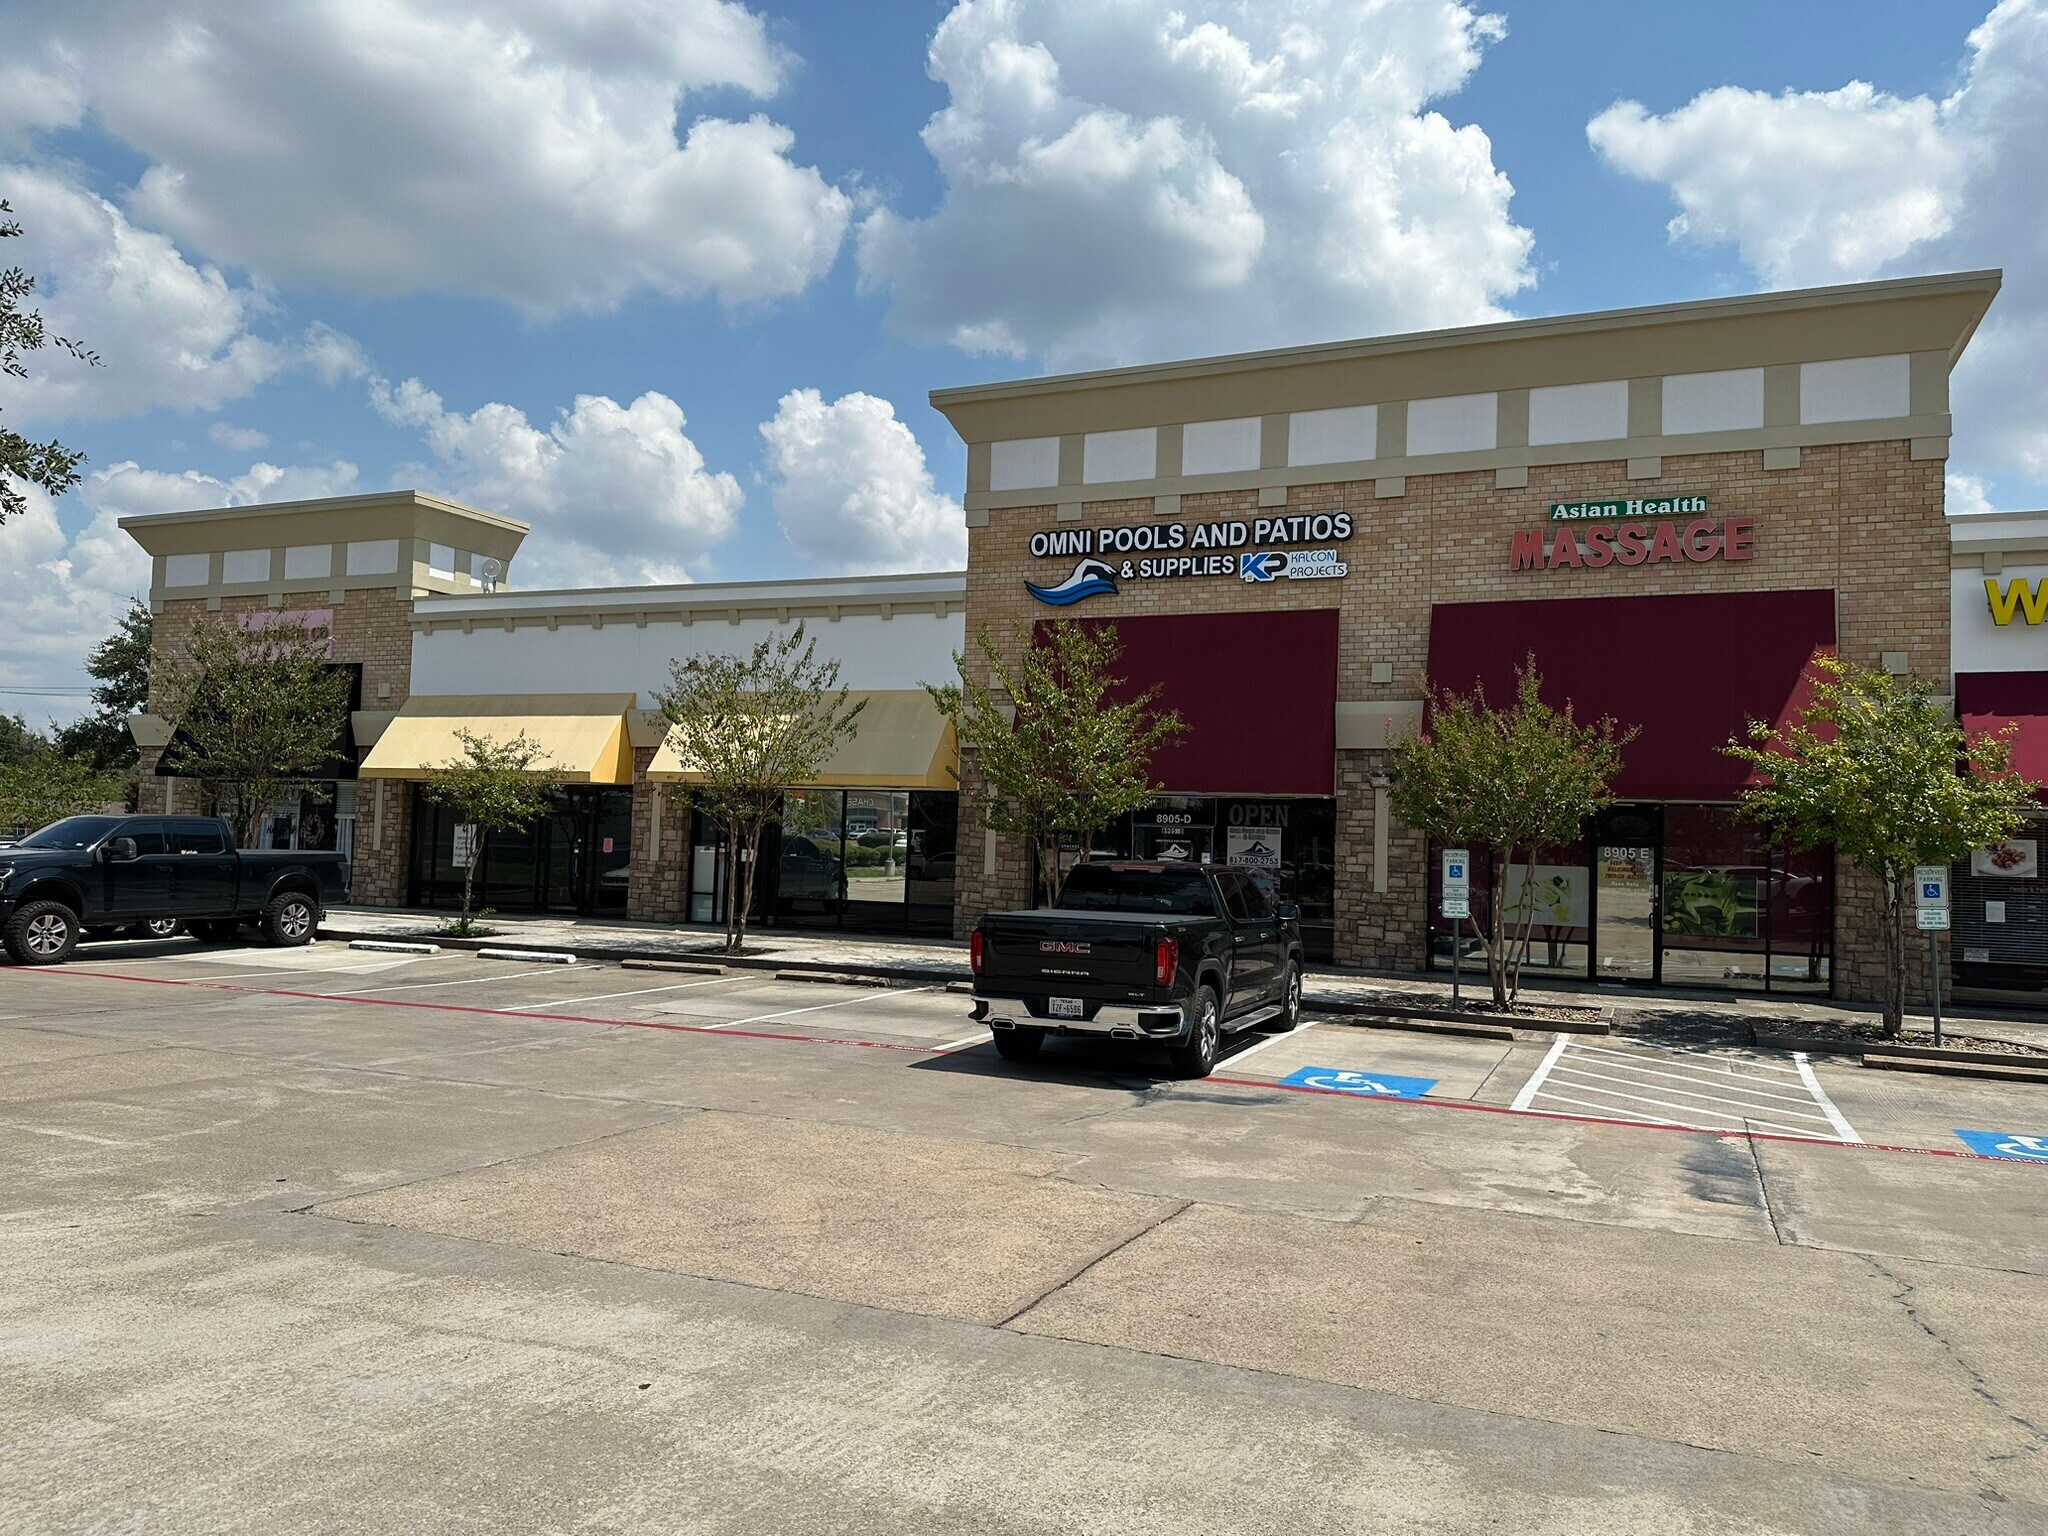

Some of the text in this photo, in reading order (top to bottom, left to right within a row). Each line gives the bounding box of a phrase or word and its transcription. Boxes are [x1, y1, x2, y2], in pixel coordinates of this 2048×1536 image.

[1553, 497, 1707, 519] Asian Health
[1030, 513, 1353, 557] OMNI POOLS AND PATIOS
[1509, 517, 1756, 571] MASSAGE
[1290, 551, 1336, 564] KALCON
[1120, 555, 1235, 578] & SUPPLIES
[1241, 552, 1288, 582] KP
[1290, 563, 1346, 578] PROJECTS
[1156, 814, 1192, 824] 8905-D
[1229, 804, 1290, 828] OPEN
[1603, 847, 1649, 858] 8905 E
[1229, 857, 1279, 865] 817-800-2753
[1039, 941, 1091, 954] GMC
[1041, 968, 1090, 976] SIERRA
